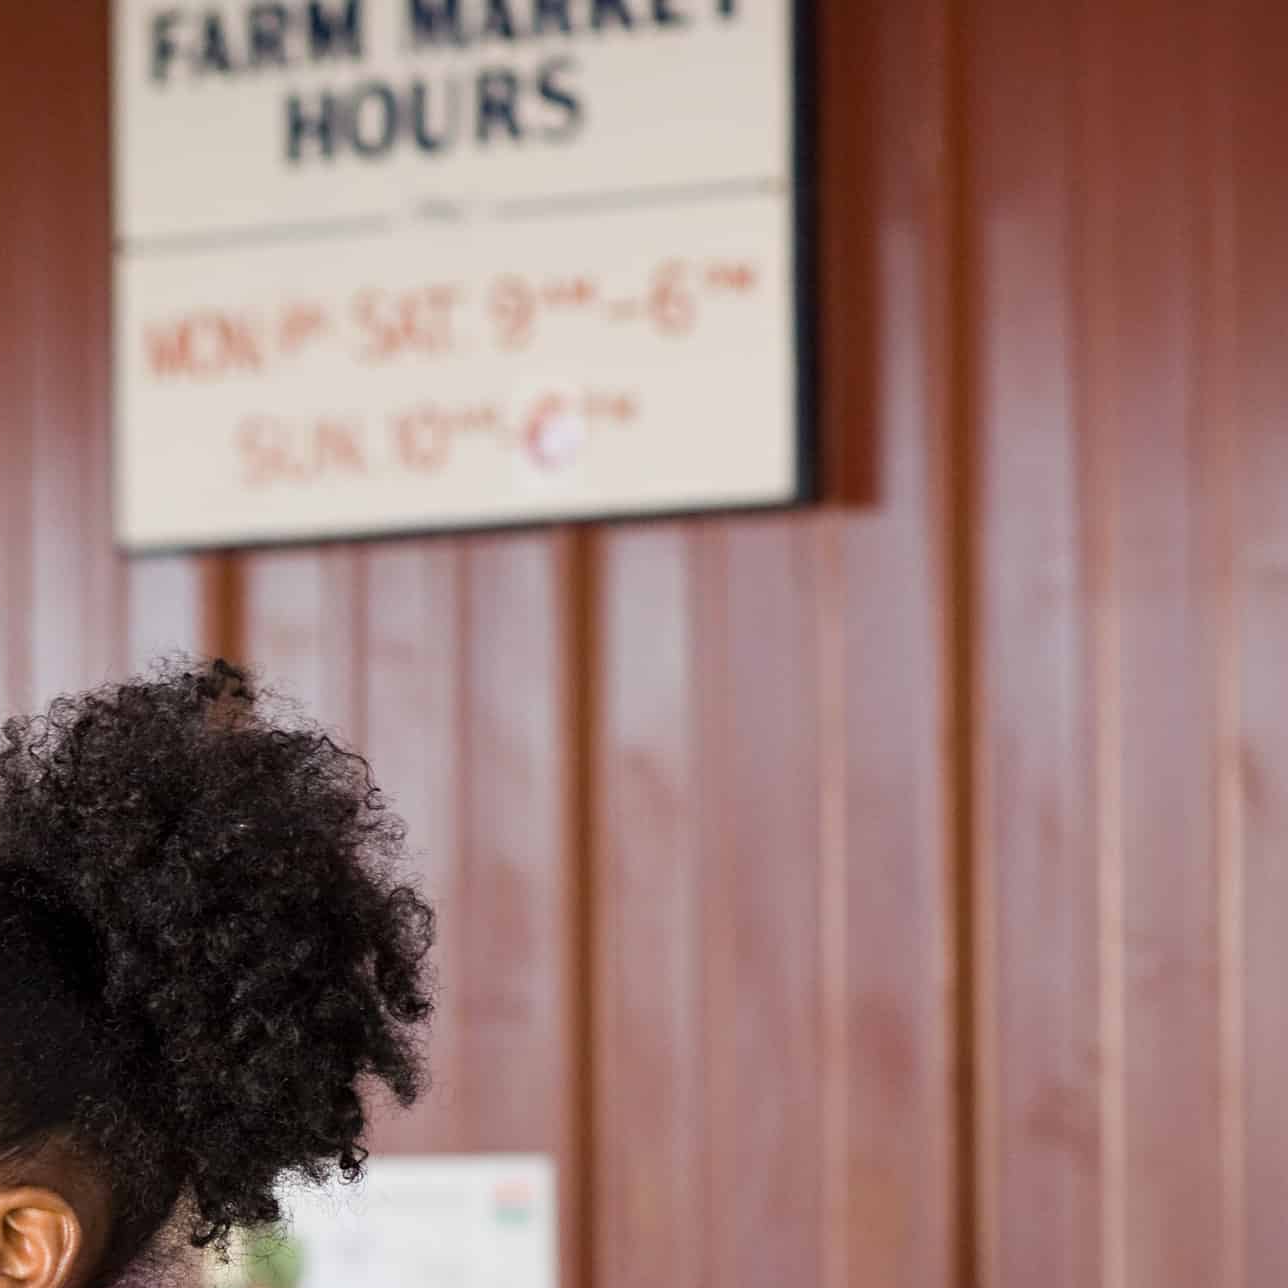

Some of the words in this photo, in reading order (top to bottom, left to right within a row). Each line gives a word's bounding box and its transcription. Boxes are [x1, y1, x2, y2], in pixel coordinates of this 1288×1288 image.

[148, 0, 364, 81] FARM
[404, 0, 740, 50] MAR
[284, 58, 582, 164] HOURS
